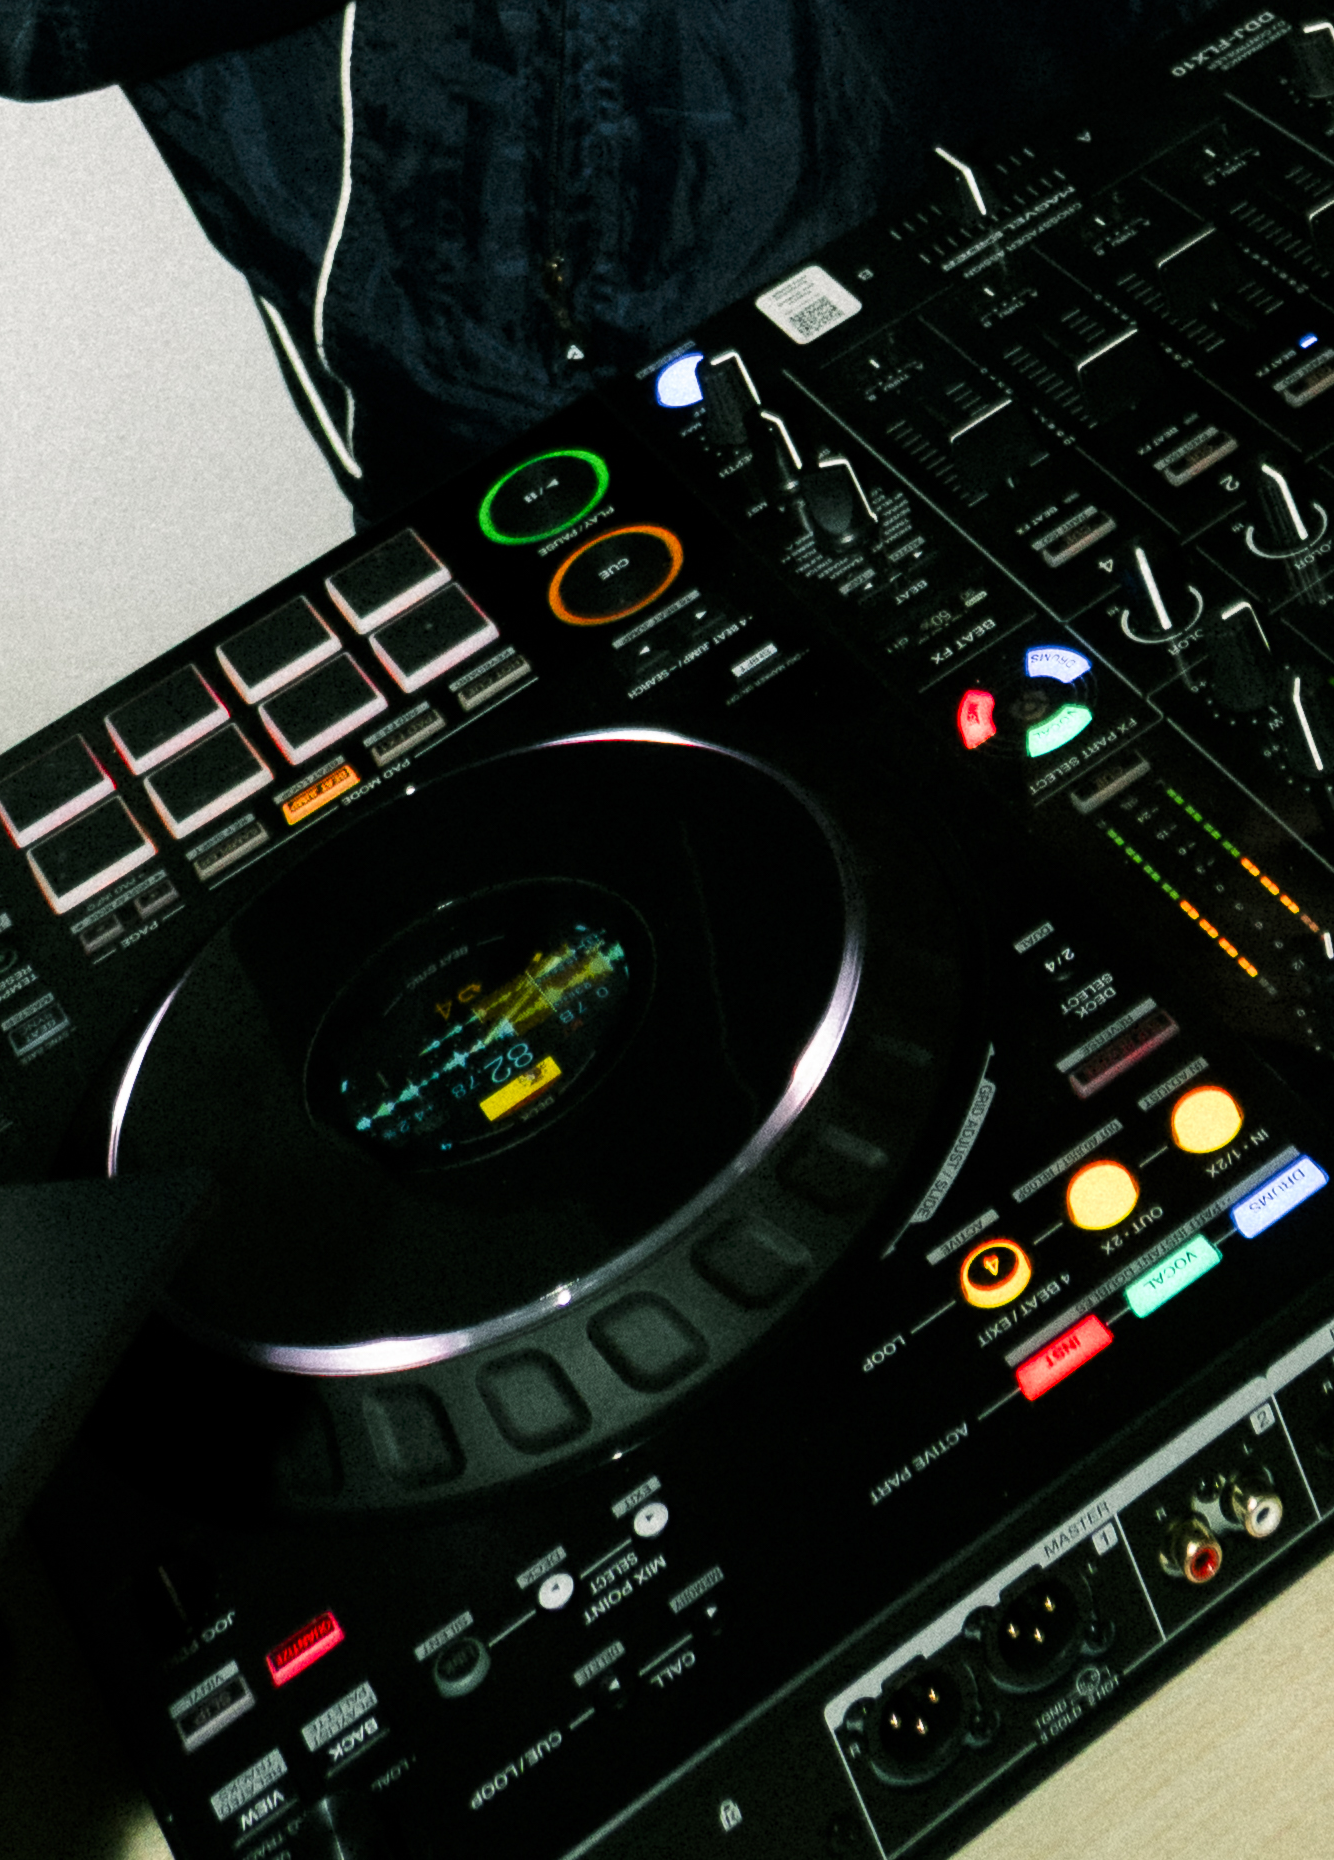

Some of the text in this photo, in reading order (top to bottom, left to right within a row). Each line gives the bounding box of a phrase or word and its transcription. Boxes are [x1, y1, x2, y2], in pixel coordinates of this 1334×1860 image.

[1172, 7, 1270, 80] DDJ-FLX10
[1073, 127, 1094, 146] A
[962, 201, 1078, 282] CROSSFADER ASSIGN
[854, 264, 875, 285] B
[1271, 347, 1297, 368] BEAT
[1151, 425, 1179, 447] BEAT
[1215, 469, 1242, 495] 2
[539, 504, 611, 557] PLAY/PAUSE
[1033, 503, 1058, 523] BEAT
[598, 554, 629, 580] CUE
[1093, 552, 1119, 578] 4
[892, 577, 926, 605] BEAT
[710, 623, 739, 645] BEAT
[928, 617, 994, 666] BEAT FX
[1027, 715, 1138, 796] FX PART SELECT
[320, 768, 347, 790] BEAT
[341, 757, 410, 806] PAD MODE
[119, 918, 158, 950] PAGE
[1042, 944, 1075, 974] 2/4
[429, 994, 458, 1023] 4
[1056, 969, 1113, 1016] SELECT
[1073, 985, 1116, 1020] DECK
[1081, 1014, 1132, 1056] REVERSE
[917, 1084, 994, 1218] GRID ADJUST SLIDE
[1204, 1146, 1241, 1178] 1/2X
[1246, 1168, 1305, 1215] DRUMS
[939, 1219, 984, 1255] ACTIVE
[1096, 1203, 1163, 1257] OUT 2X
[976, 1247, 1006, 1279] 4
[1142, 1247, 1197, 1293] VOCAL
[857, 1333, 906, 1373] LOOP
[1042, 1335, 1081, 1368] INST
[1253, 1408, 1275, 1431] 2
[864, 1422, 971, 1506] ACTIVE PART
[621, 1483, 651, 1509] EXIT
[1154, 1506, 1169, 1521] R
[1042, 1501, 1113, 1557] MASTER
[1096, 1530, 1114, 1548] 1
[578, 1552, 668, 1625] MIX POINT
[585, 1550, 638, 1594] SELECT
[198, 1609, 238, 1644] JOG
[648, 1650, 697, 1690] CALL
[189, 1690, 233, 1726] SLIP
[325, 1716, 379, 1762] BACK
[464, 1730, 565, 1808] CUE/LOOP
[234, 1787, 285, 1830] VIEW
